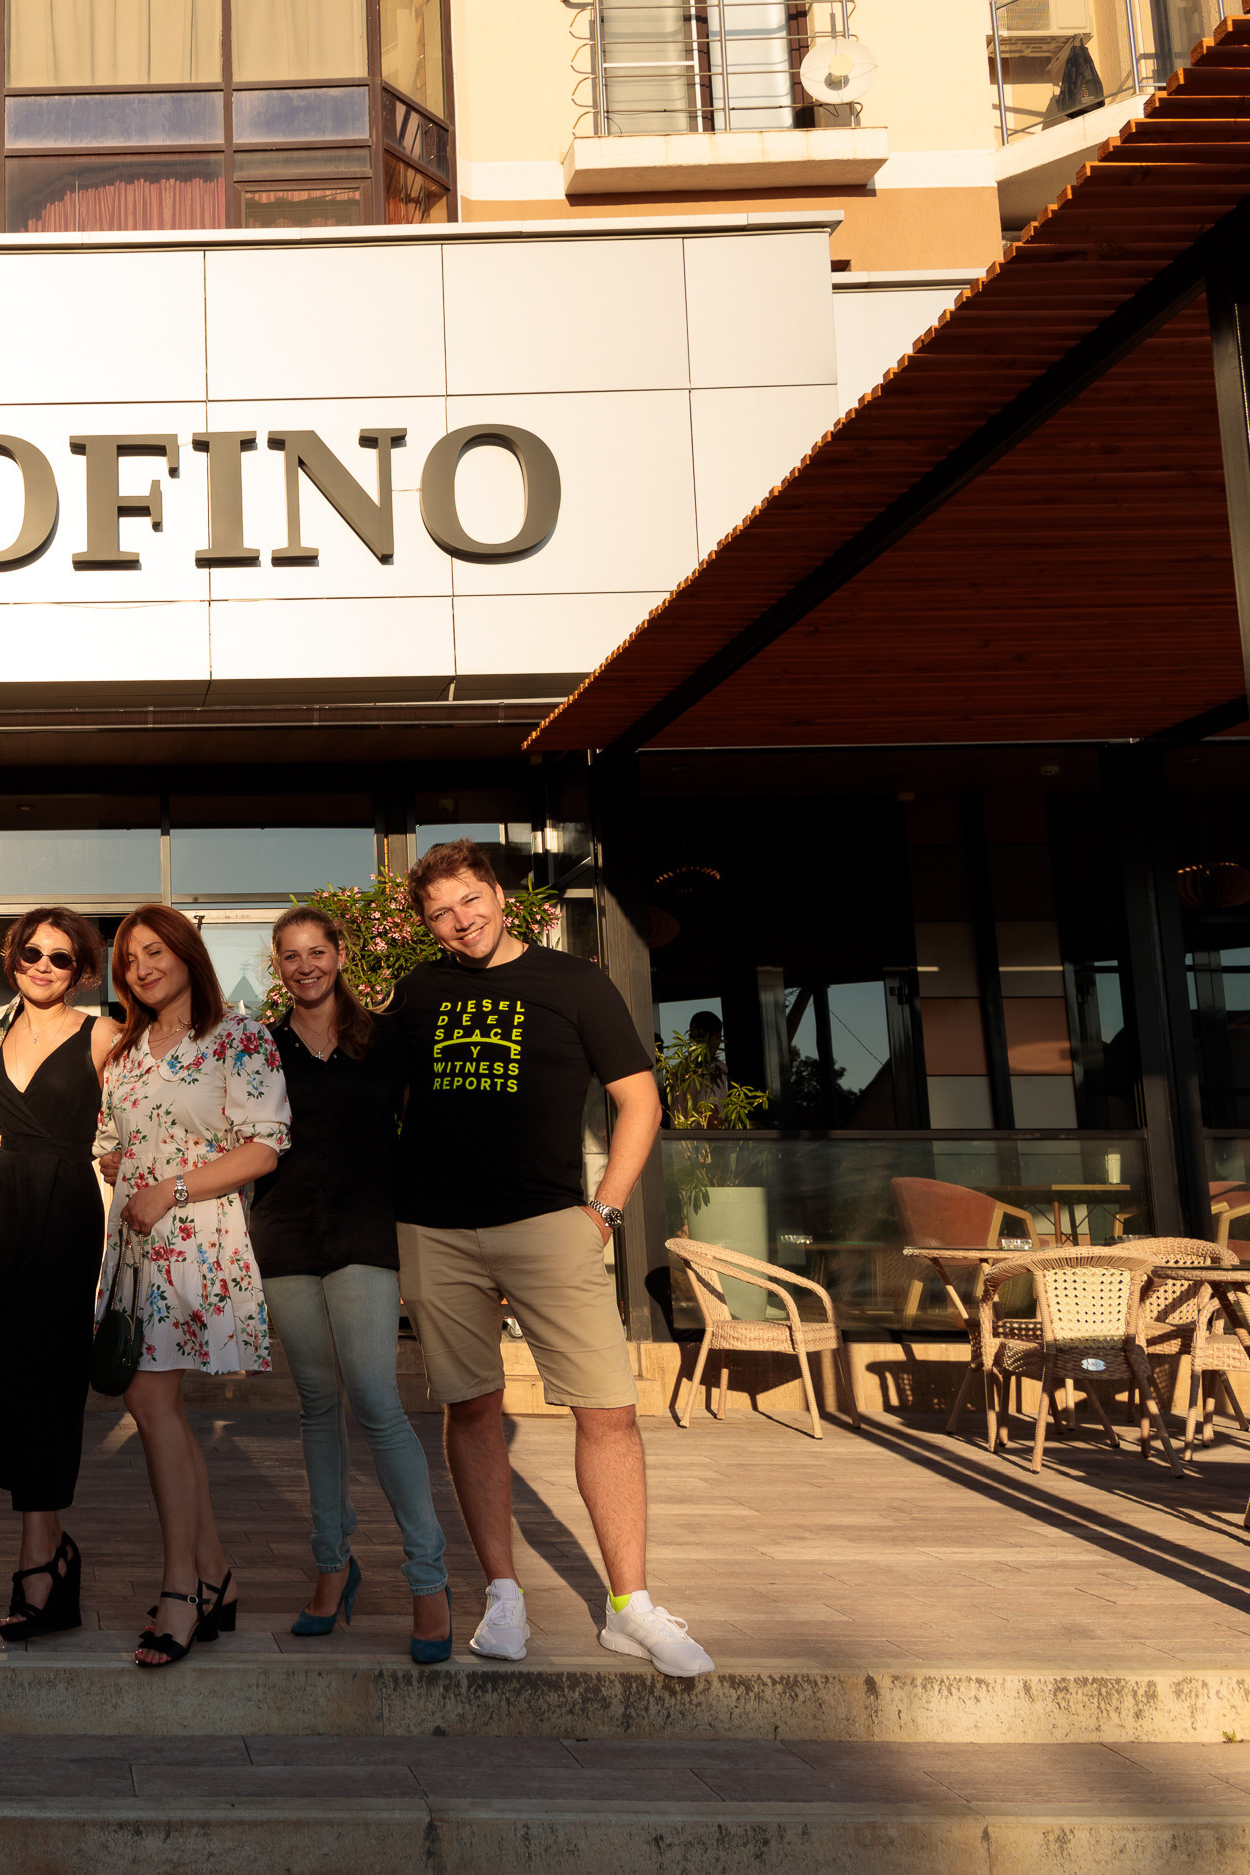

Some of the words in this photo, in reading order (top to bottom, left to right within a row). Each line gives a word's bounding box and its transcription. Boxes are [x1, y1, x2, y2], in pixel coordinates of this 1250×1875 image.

[439, 999, 525, 1012] DIESEL
[437, 1014, 525, 1026] DEEP
[434, 1028, 523, 1041] SPACE
[433, 1045, 521, 1059] EYE
[433, 1062, 519, 1075] WITNESS
[433, 1077, 518, 1093] REPORTS
